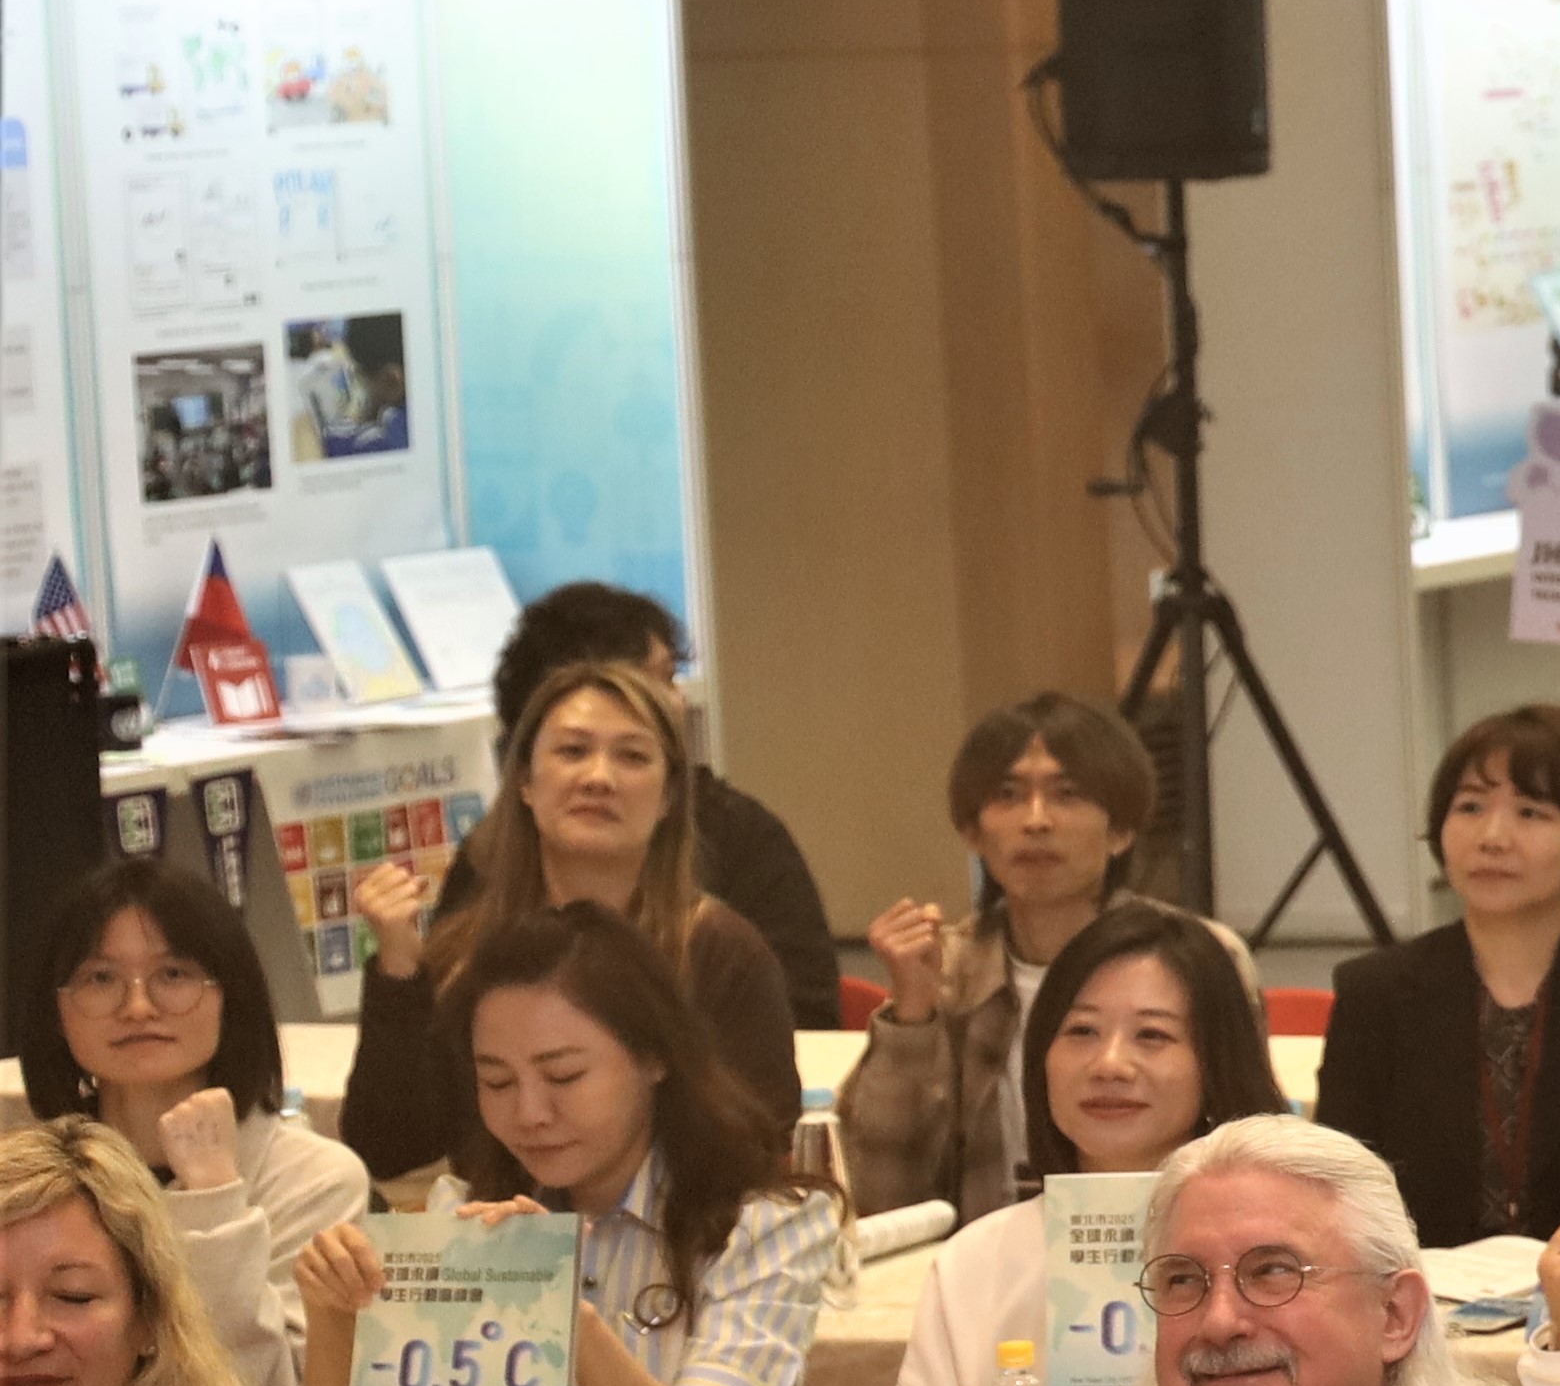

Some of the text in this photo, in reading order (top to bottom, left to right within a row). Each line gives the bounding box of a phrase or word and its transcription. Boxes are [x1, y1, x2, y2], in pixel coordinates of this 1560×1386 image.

[382, 756, 457, 793] GOALS
[1069, 1228, 1135, 1244] 全球永續
[441, 1267, 556, 1284] Global Sustainable
